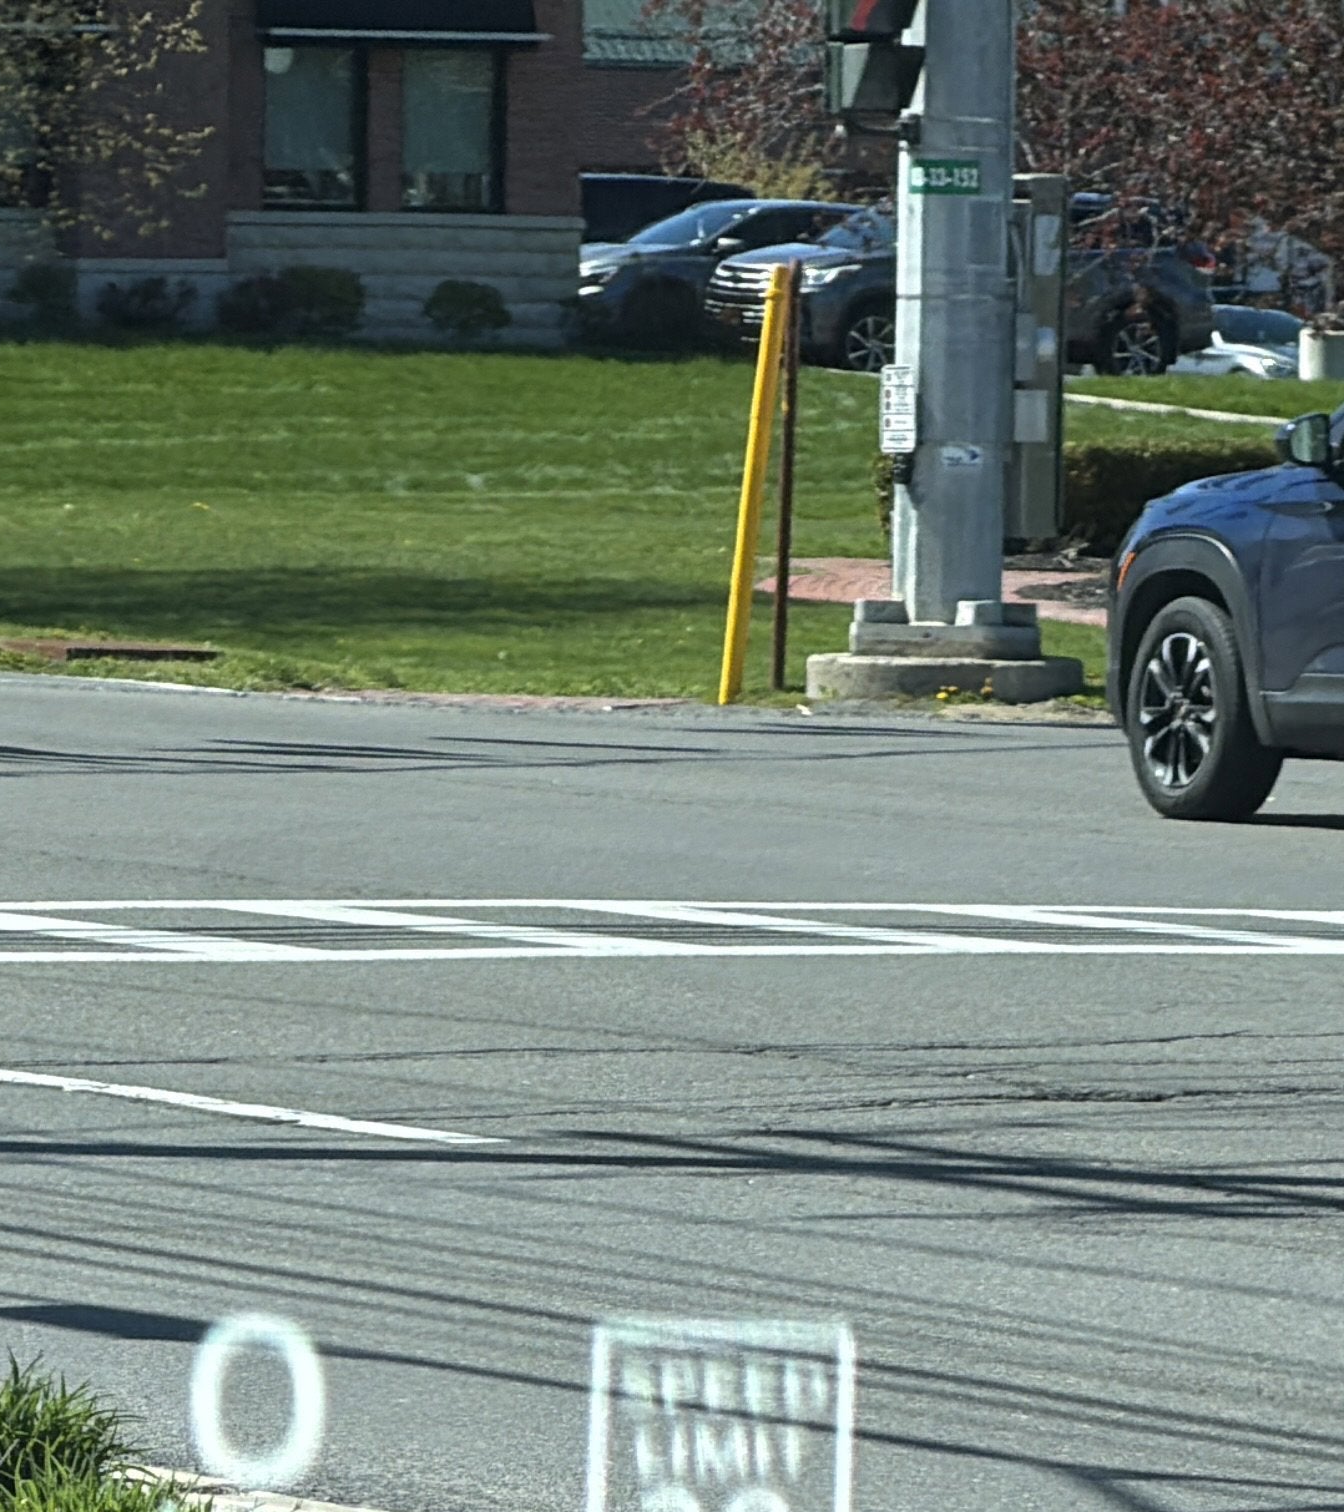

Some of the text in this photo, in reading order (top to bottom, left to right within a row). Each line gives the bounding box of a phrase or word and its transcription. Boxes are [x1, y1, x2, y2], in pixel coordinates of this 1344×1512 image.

[910, 167, 979, 188] -33-152
[190, 1312, 325, 1486] 0
[618, 1355, 829, 1414] SPEED
[635, 1421, 813, 1481] LIMIT
